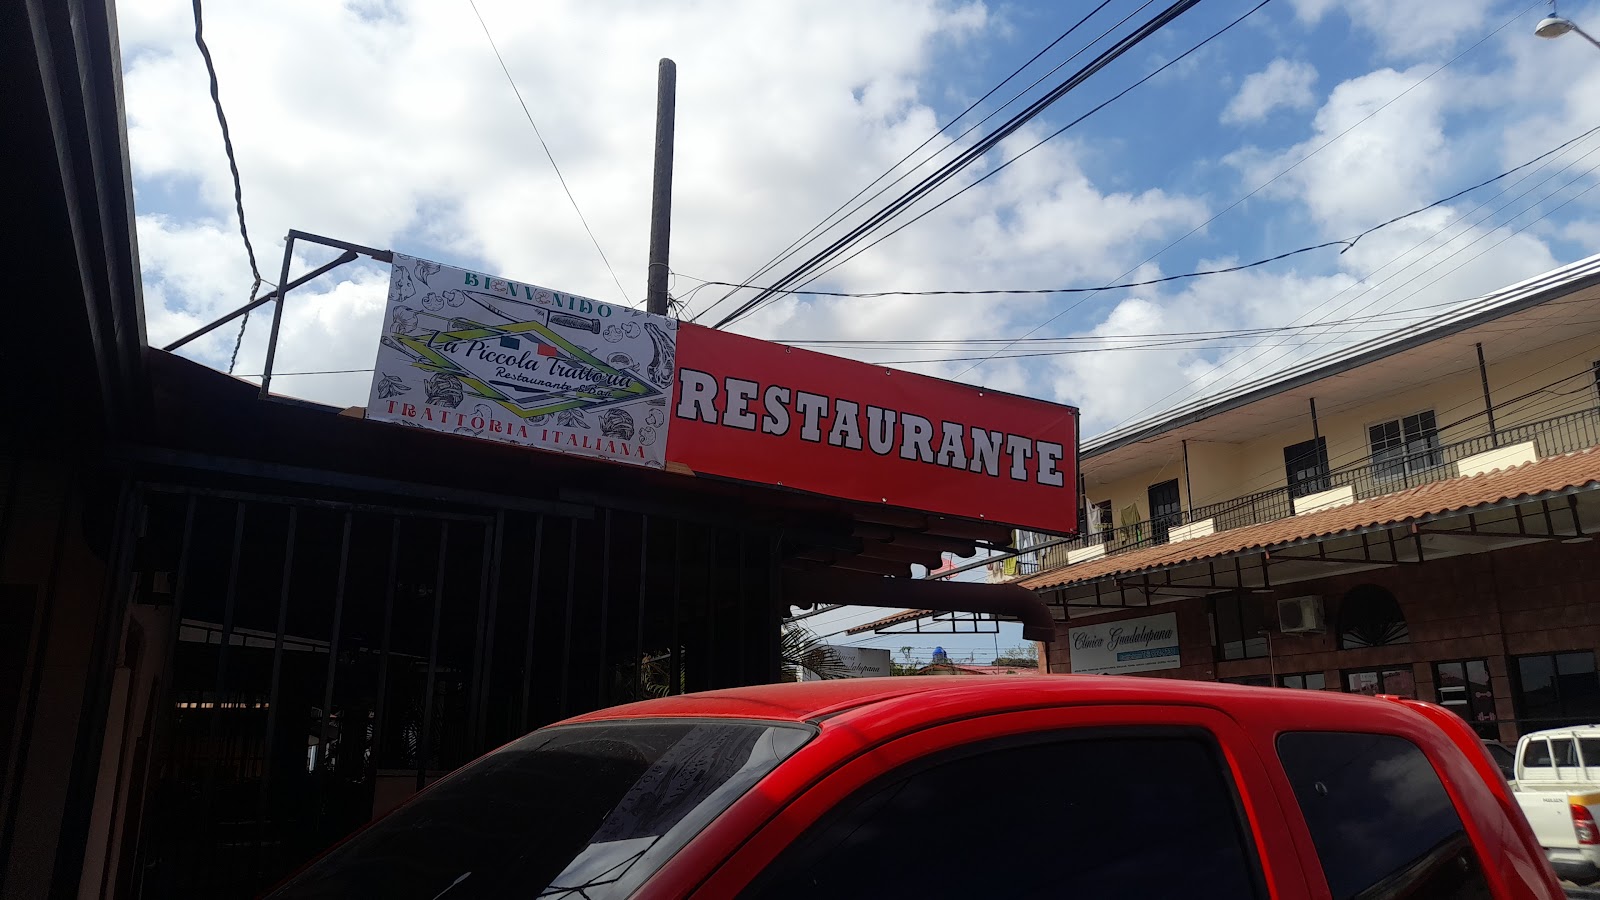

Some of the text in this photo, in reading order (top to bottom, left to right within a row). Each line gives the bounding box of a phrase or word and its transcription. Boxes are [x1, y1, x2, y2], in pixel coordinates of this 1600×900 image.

[464, 272, 612, 318] BIENVENIDO
[425, 329, 632, 388] La Piccola Trattoria
[495, 366, 573, 391] Restaurante
[386, 400, 645, 459] TRATTORIA ITALIANA
[675, 368, 1065, 488] RESTAURANTE
[1106, 625, 1173, 651] Guadalupana
